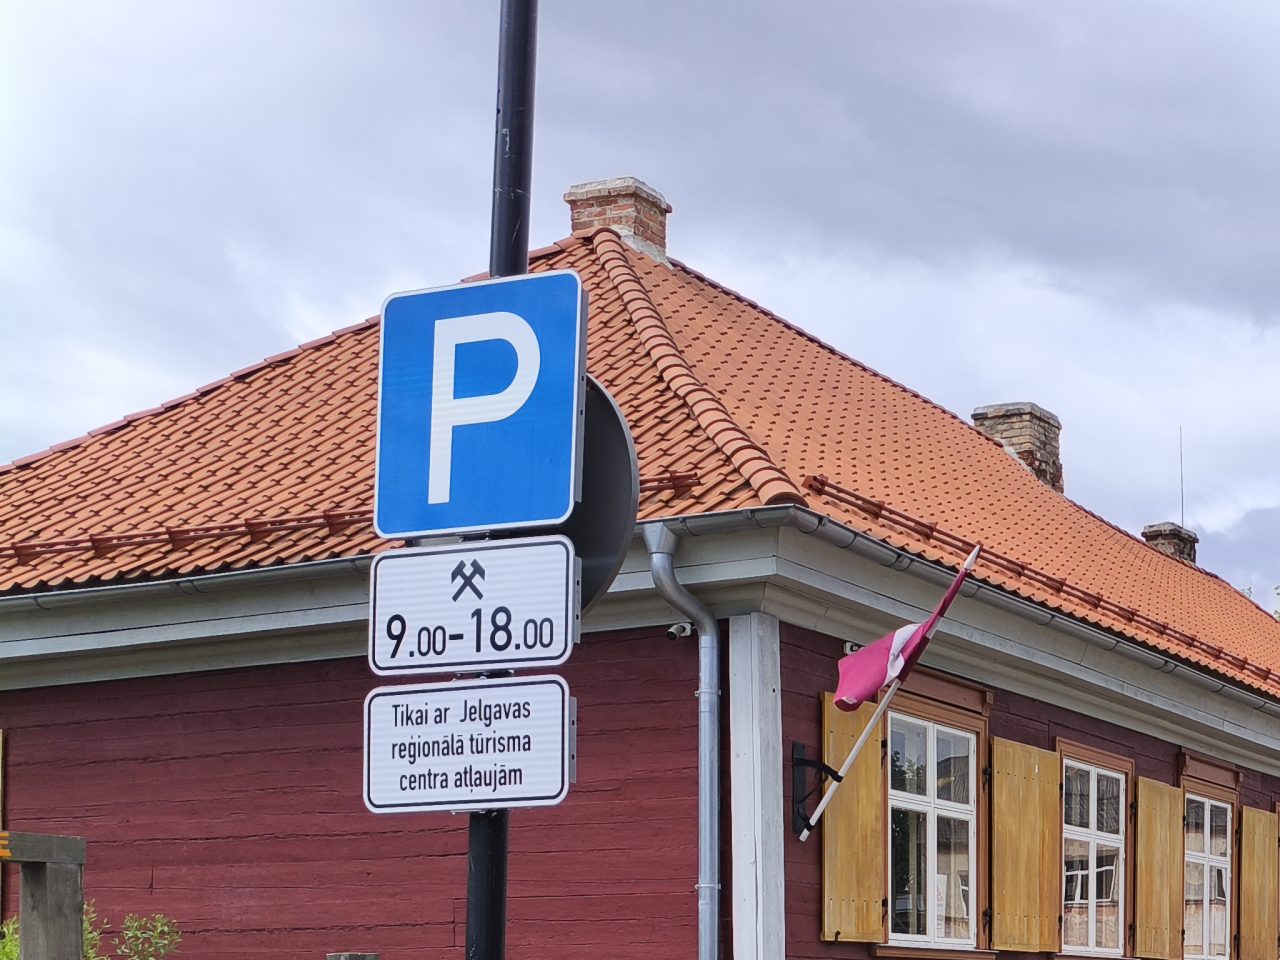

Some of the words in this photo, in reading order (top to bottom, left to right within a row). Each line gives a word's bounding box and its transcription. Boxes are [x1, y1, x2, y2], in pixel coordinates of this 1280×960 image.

[427, 311, 541, 505] P
[392, 701, 429, 728] Tikai
[433, 706, 451, 725] ar
[459, 697, 532, 728] Jelgavas
[391, 732, 464, 766] reģionālā
[469, 729, 532, 755] tūrisma
[399, 767, 449, 792] centra
[454, 762, 524, 794] atļaujām
